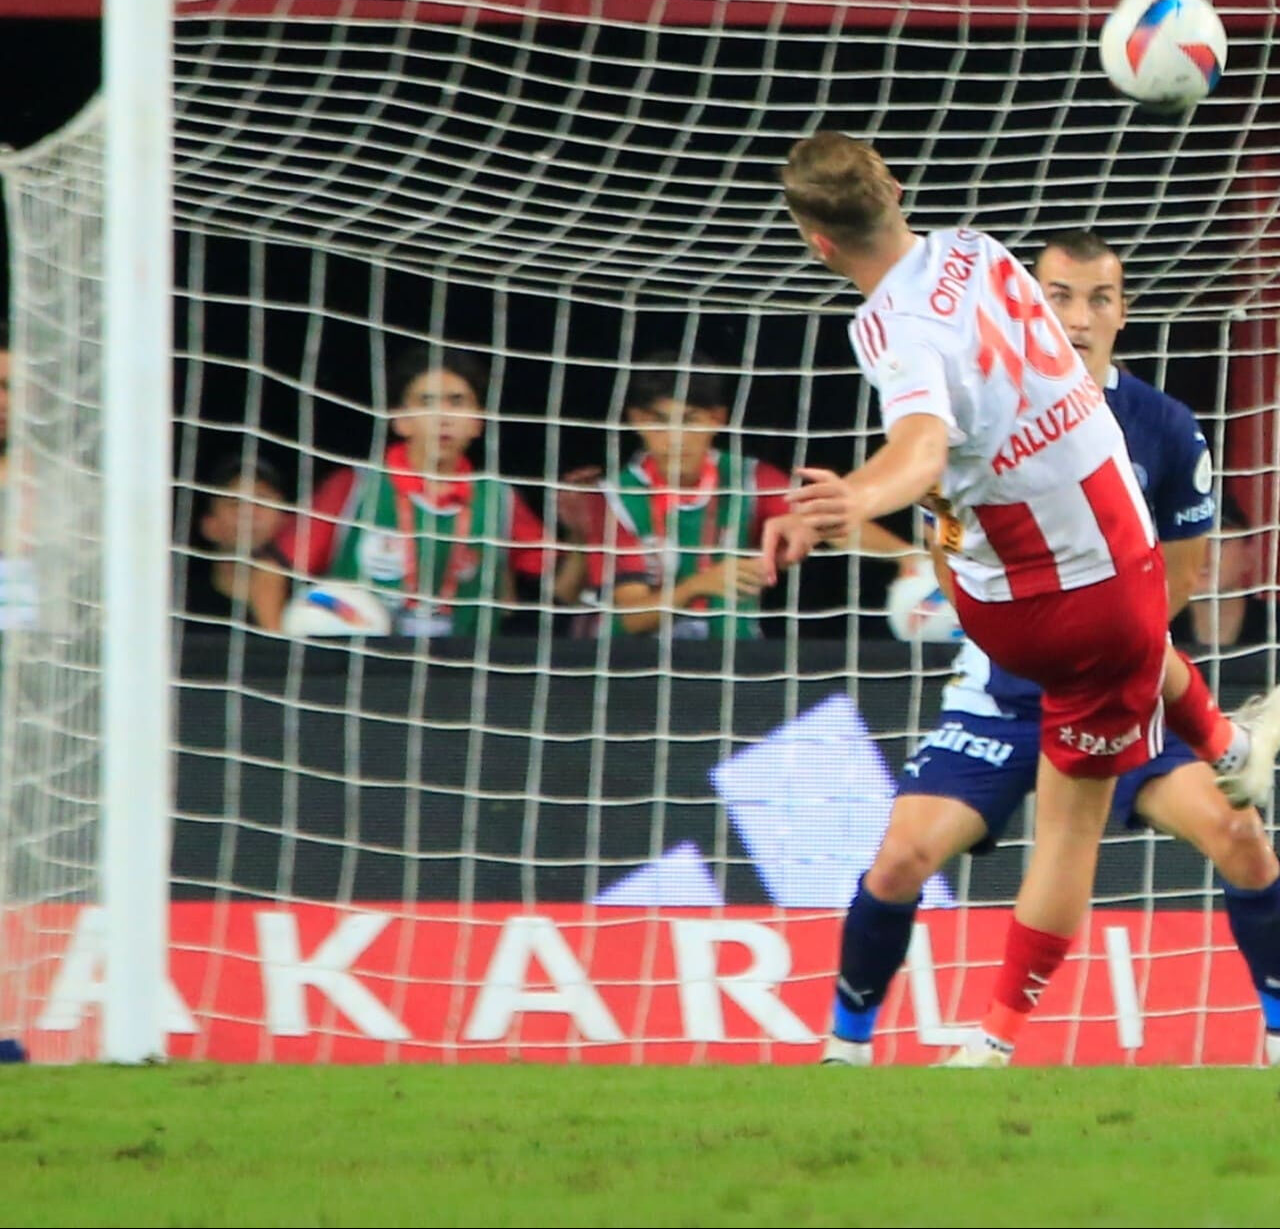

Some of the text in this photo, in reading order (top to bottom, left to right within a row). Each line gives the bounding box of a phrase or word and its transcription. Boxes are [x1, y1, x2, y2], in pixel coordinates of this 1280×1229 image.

[929, 247, 979, 317] anex
[916, 721, 1015, 769] ürsu
[33, 908, 822, 1046] AKAR
